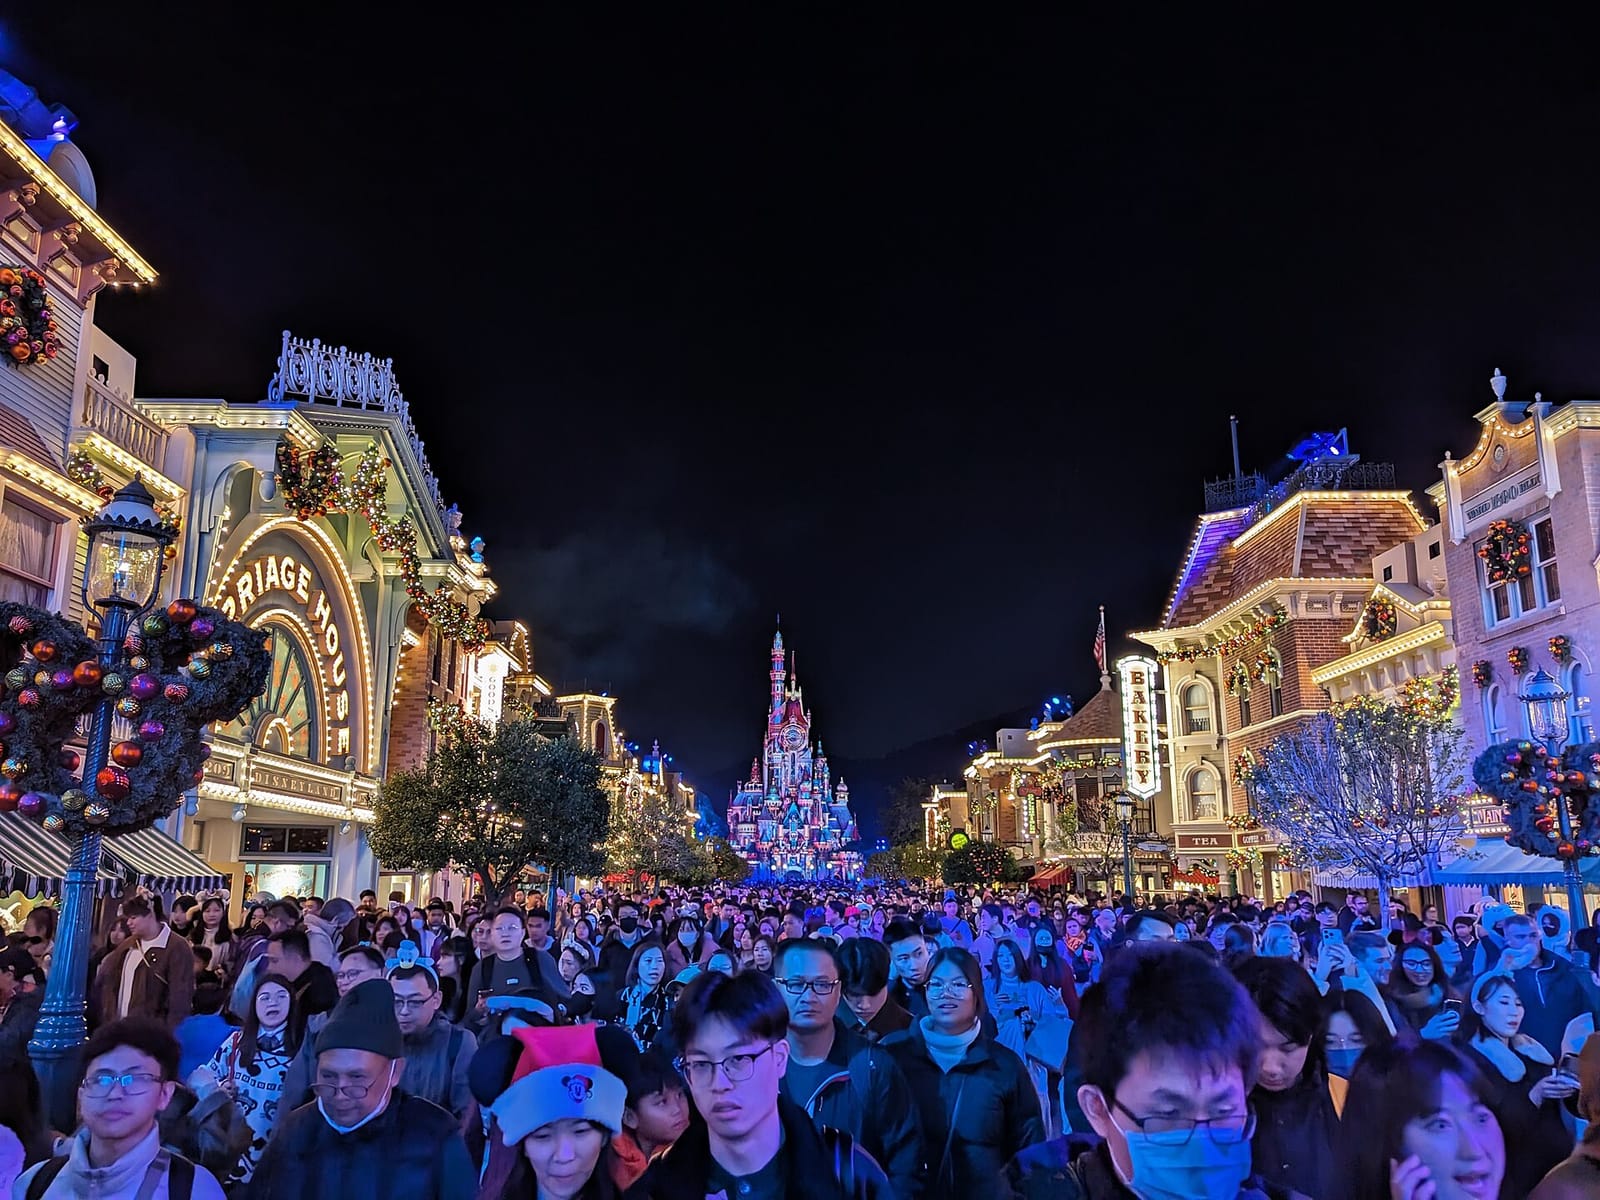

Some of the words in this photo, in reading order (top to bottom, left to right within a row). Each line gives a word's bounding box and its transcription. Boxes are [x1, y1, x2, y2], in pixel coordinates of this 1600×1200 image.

[221, 555, 312, 621] RRIAGE
[314, 590, 350, 754] HOUSE
[1130, 671, 1150, 784] BAKERY
[254, 772, 337, 798] DISNEYLAND
[1477, 808, 1503, 824] MAIN
[1192, 837, 1219, 846] TEA
